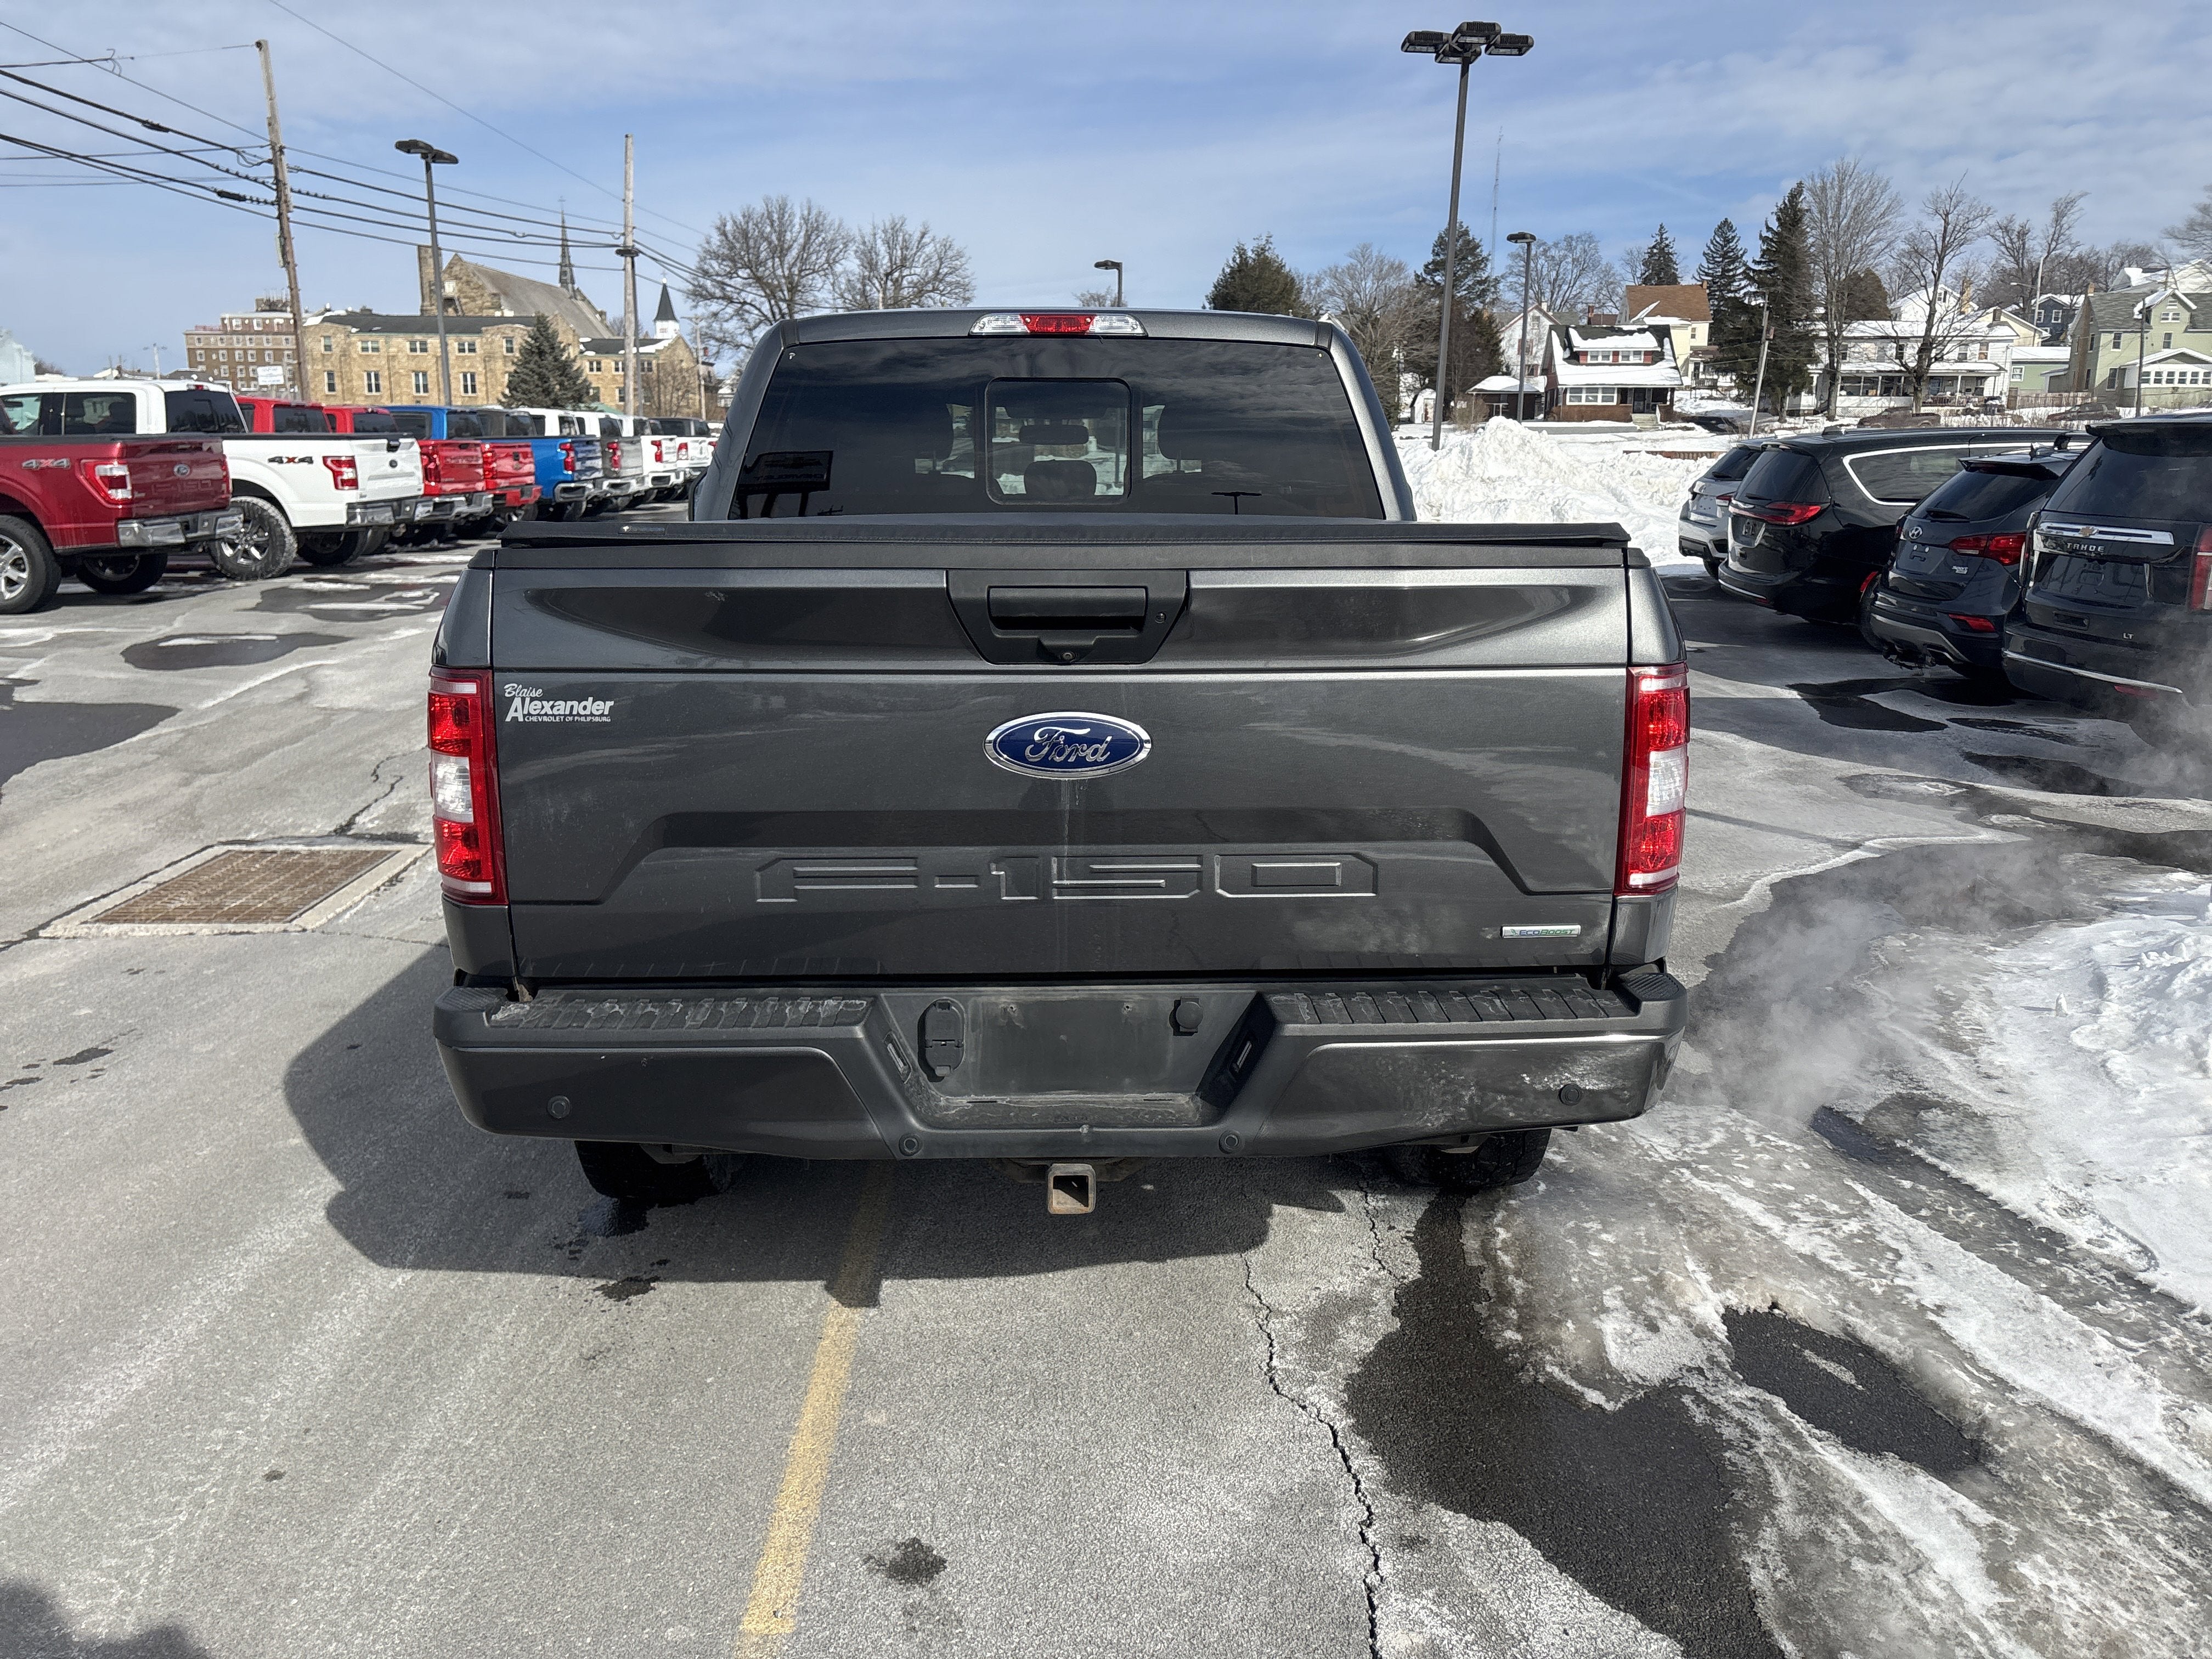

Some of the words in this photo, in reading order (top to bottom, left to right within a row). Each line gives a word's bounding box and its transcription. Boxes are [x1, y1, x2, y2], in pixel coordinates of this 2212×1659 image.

[2067, 543, 2105, 552] TAHOE
[504, 683, 544, 698] Blaise
[505, 697, 614, 722] Alexander
[1024, 726, 1113, 763] Ford
[754, 853, 1378, 904] F-150
